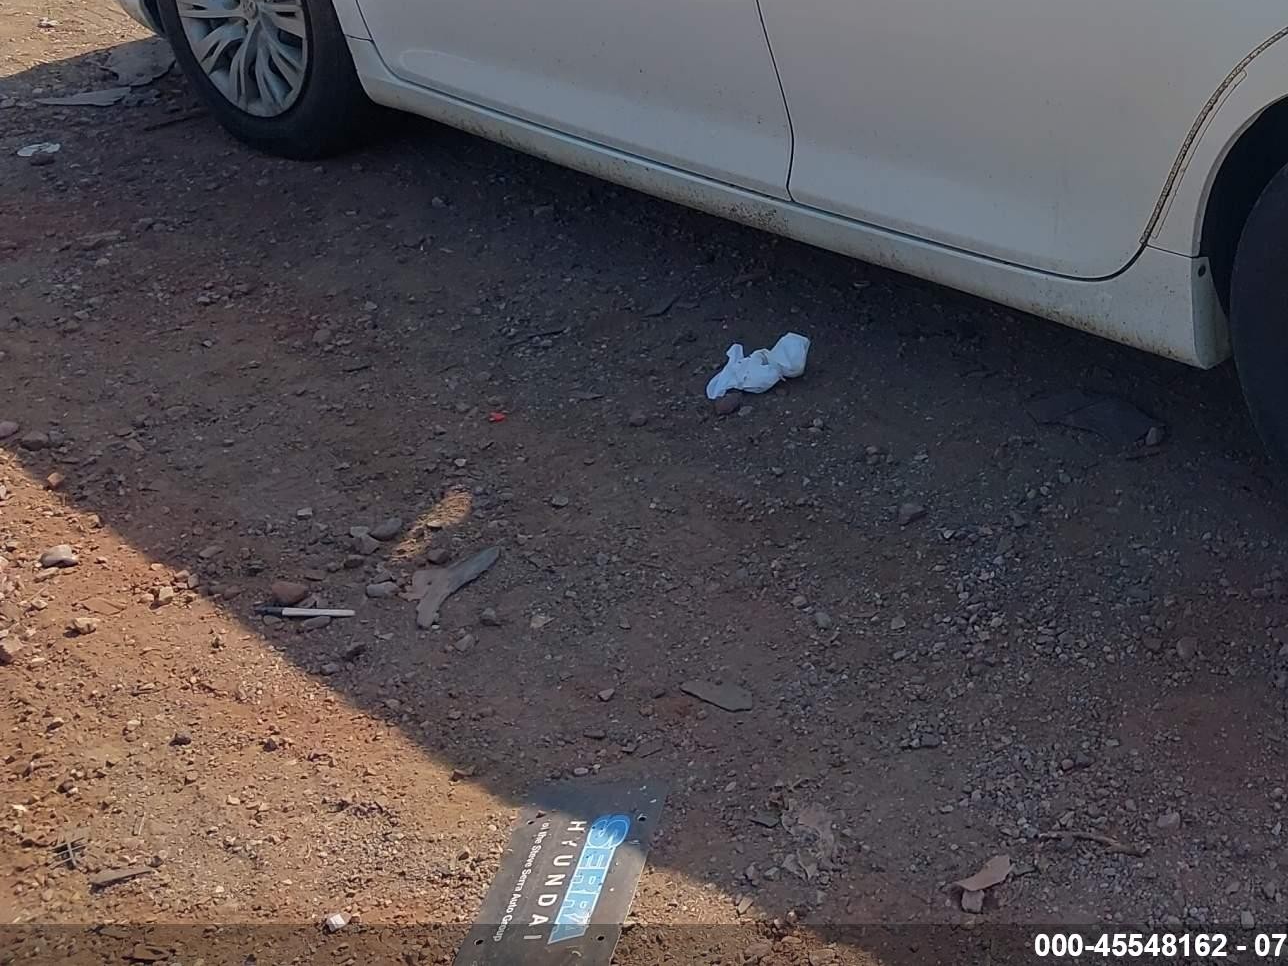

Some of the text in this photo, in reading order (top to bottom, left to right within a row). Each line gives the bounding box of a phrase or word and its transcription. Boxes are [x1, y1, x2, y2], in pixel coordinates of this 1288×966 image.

[534, 831, 548, 845] the
[524, 844, 542, 868] Steve
[514, 868, 532, 892] Serra
[523, 820, 588, 940] HYUNDAI
[505, 893, 522, 914] Auto
[492, 914, 513, 942] Group
